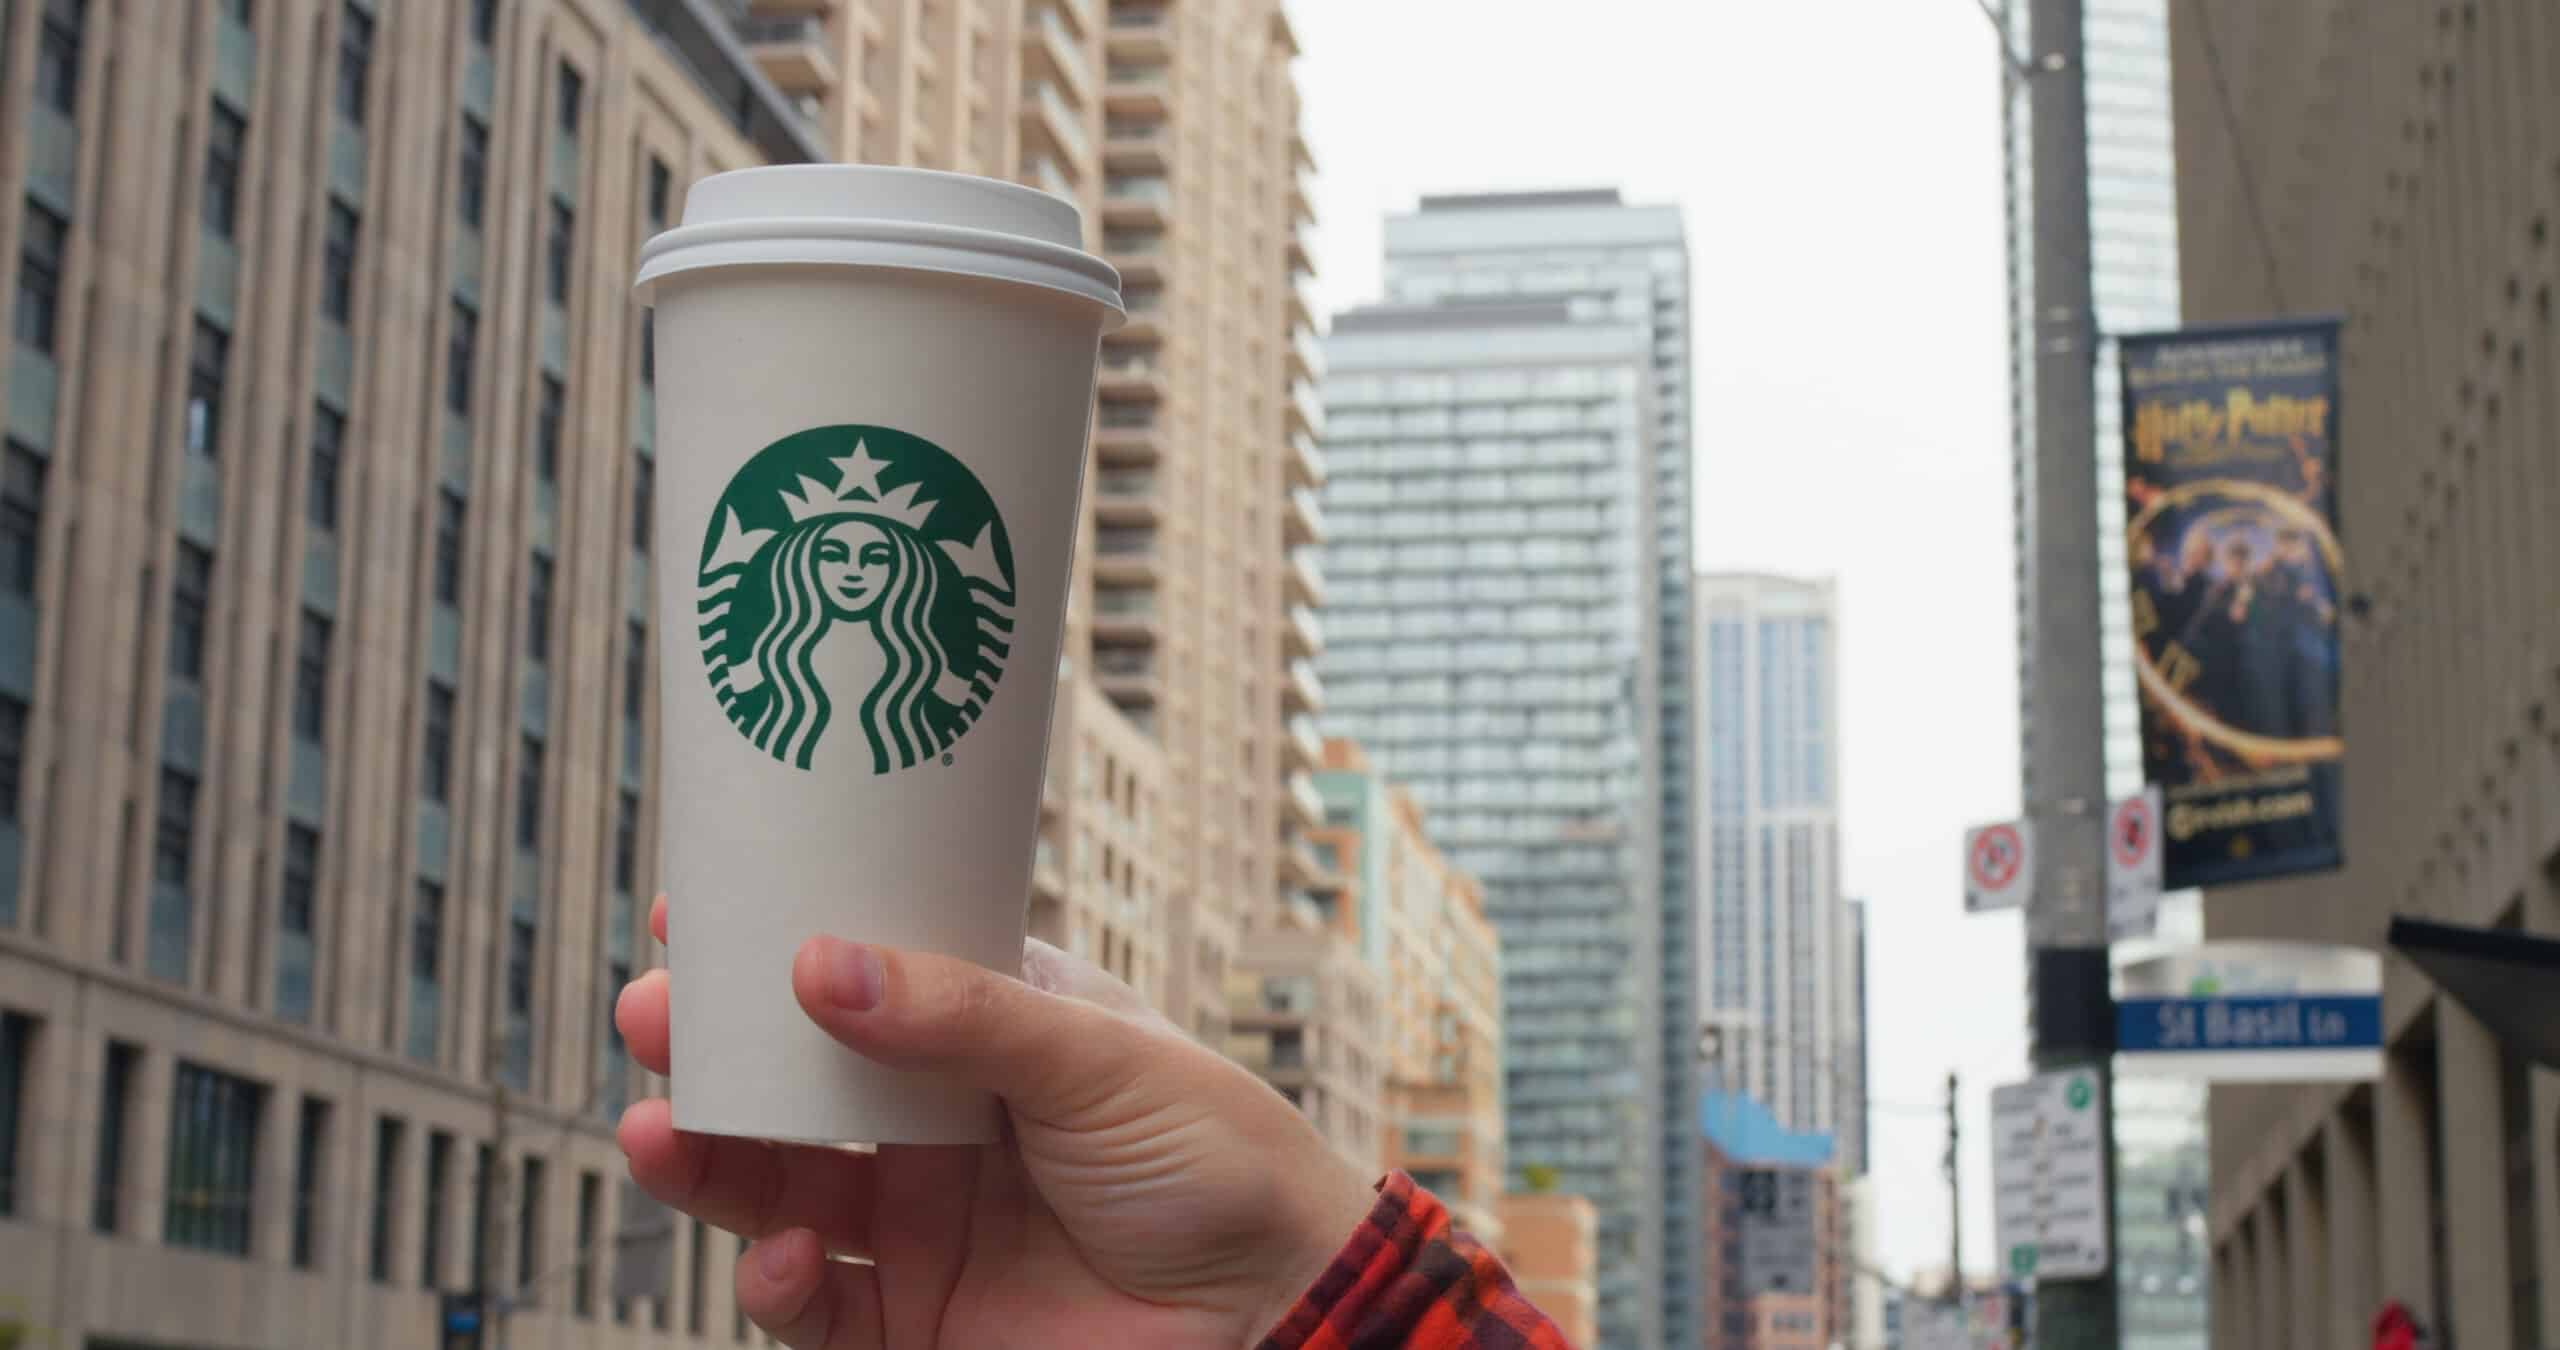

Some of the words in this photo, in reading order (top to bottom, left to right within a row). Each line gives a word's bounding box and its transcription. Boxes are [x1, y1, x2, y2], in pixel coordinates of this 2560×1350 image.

[2225, 387, 2330, 447] Potter
[2158, 1001, 2196, 1047] St
[2203, 1000, 2300, 1045] Basil
[2307, 1005, 2347, 1042] Ln
